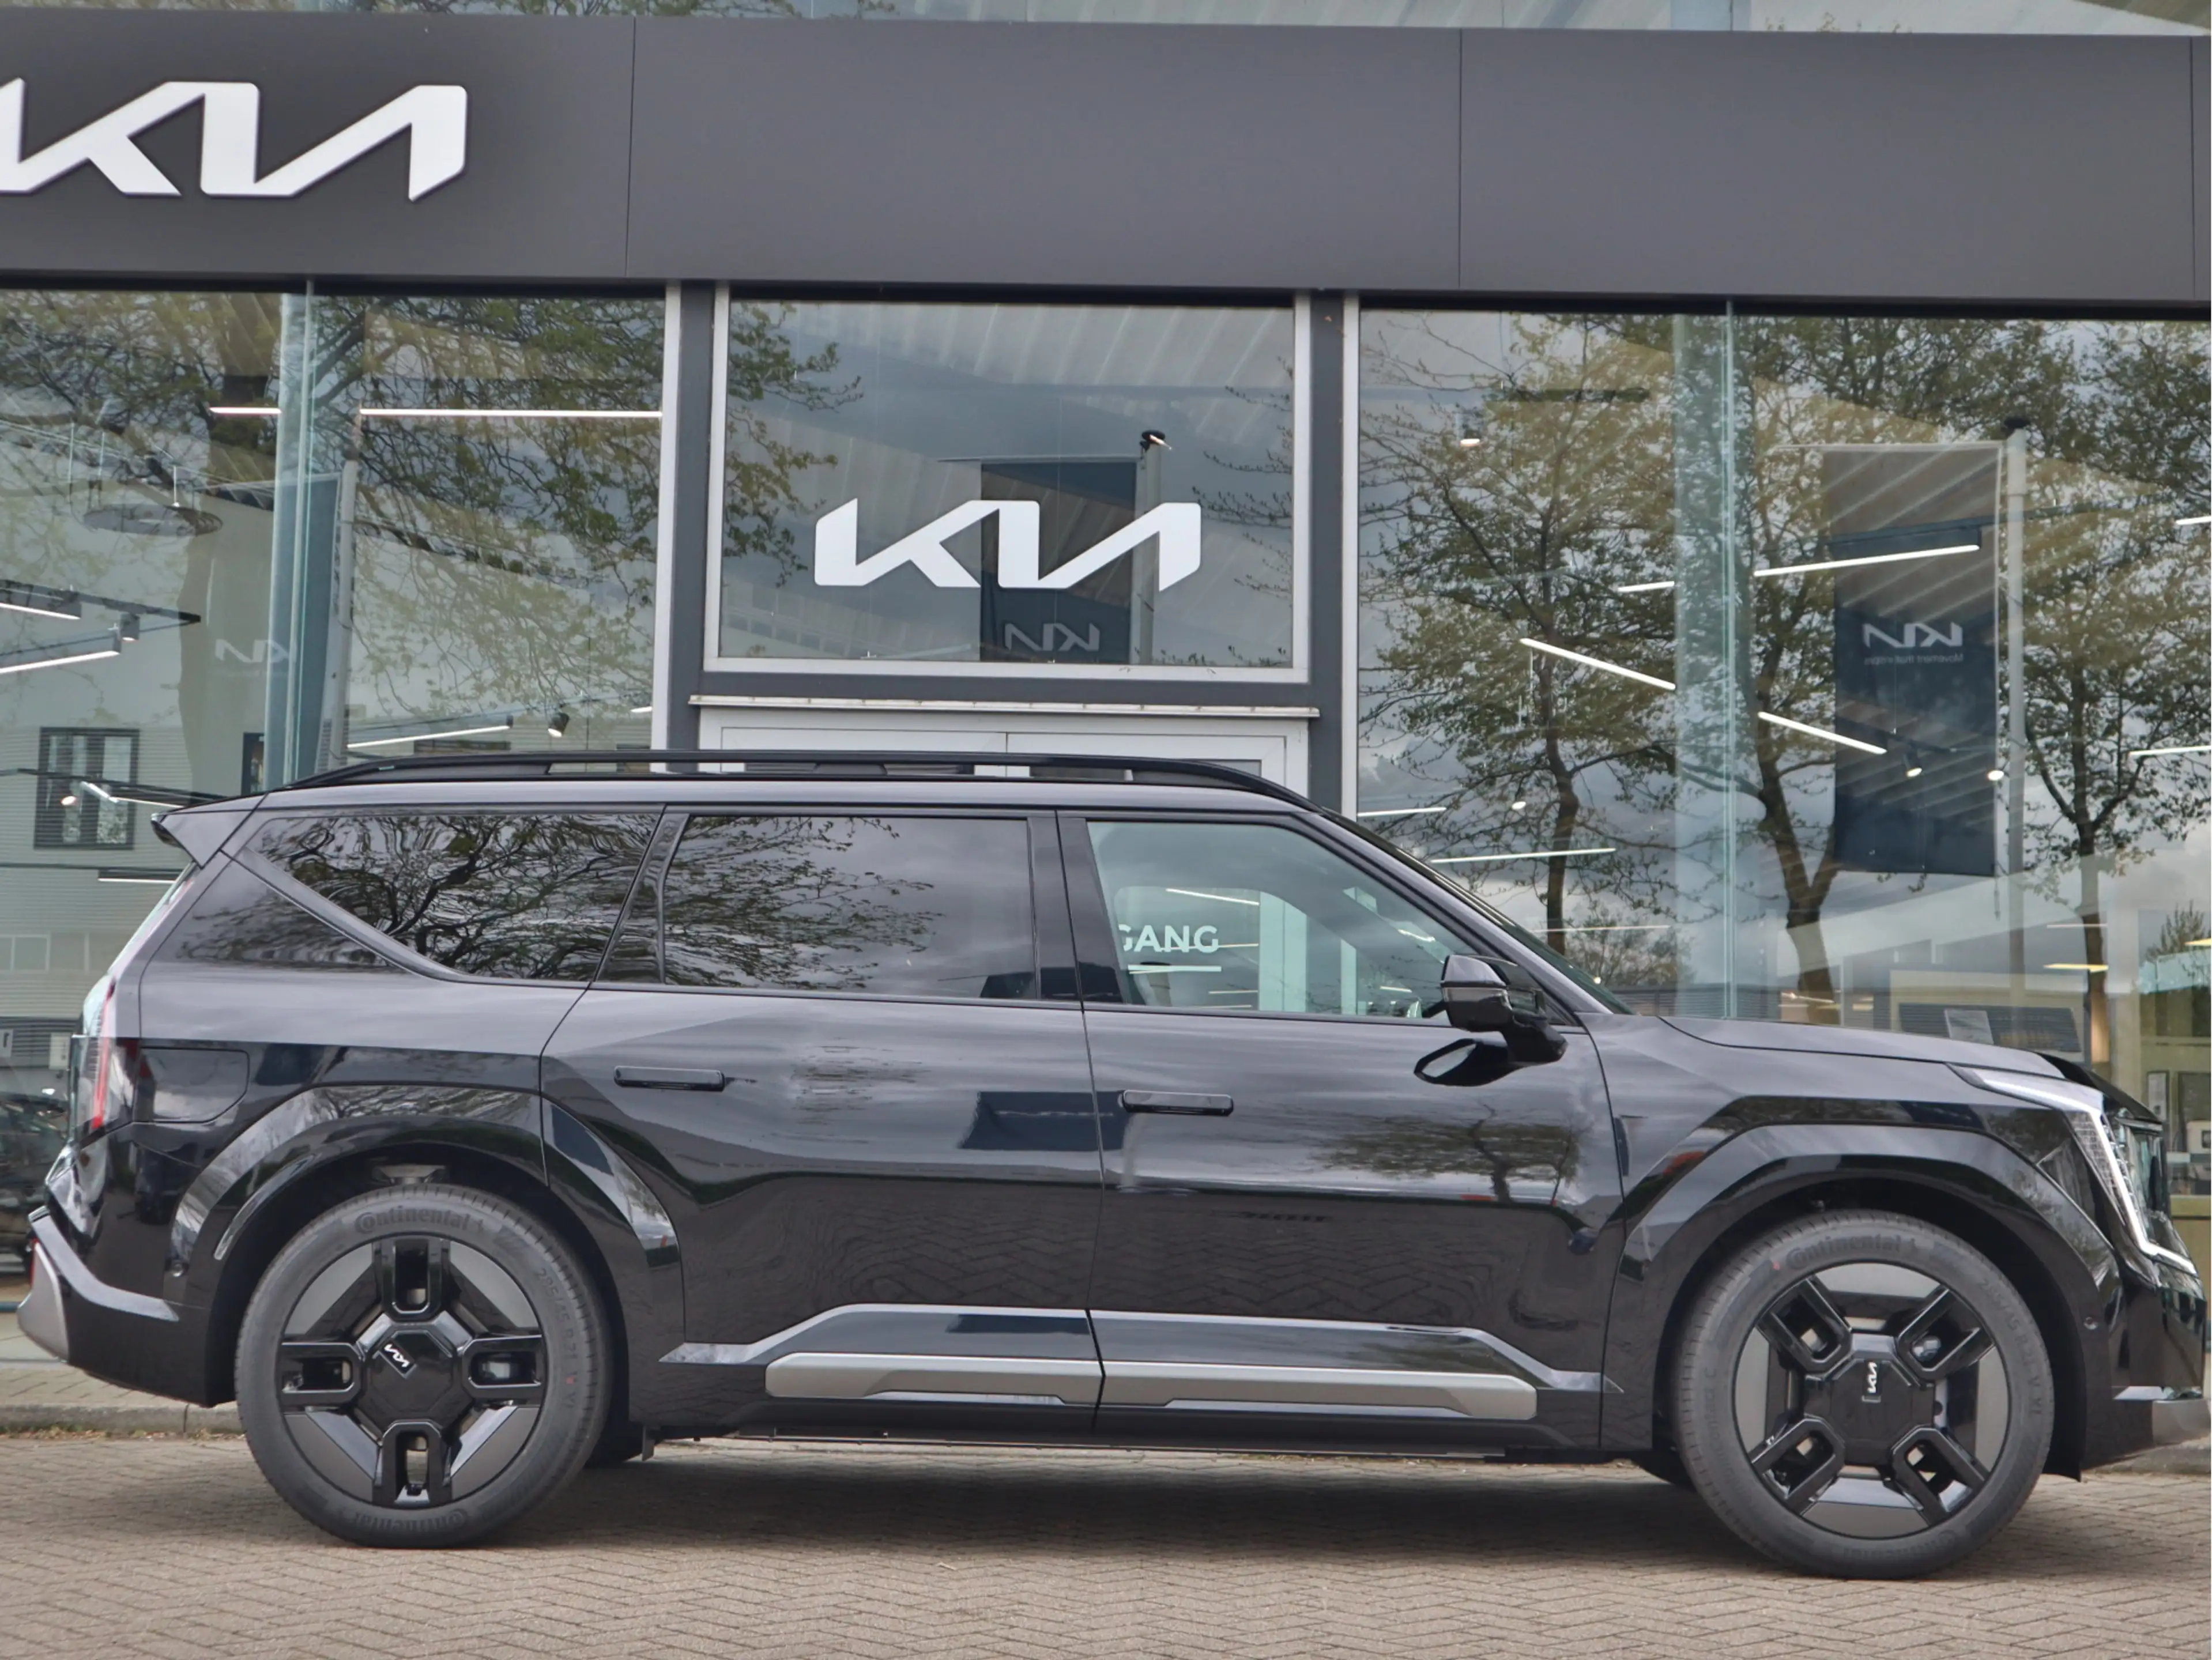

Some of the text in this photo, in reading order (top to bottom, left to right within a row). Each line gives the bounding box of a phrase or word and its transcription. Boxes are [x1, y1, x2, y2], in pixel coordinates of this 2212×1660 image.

[0, 77, 468, 202] KIA
[814, 498, 1201, 592] KIA
[354, 1206, 470, 1233] Continental
[1785, 1234, 1901, 1270] Continental
